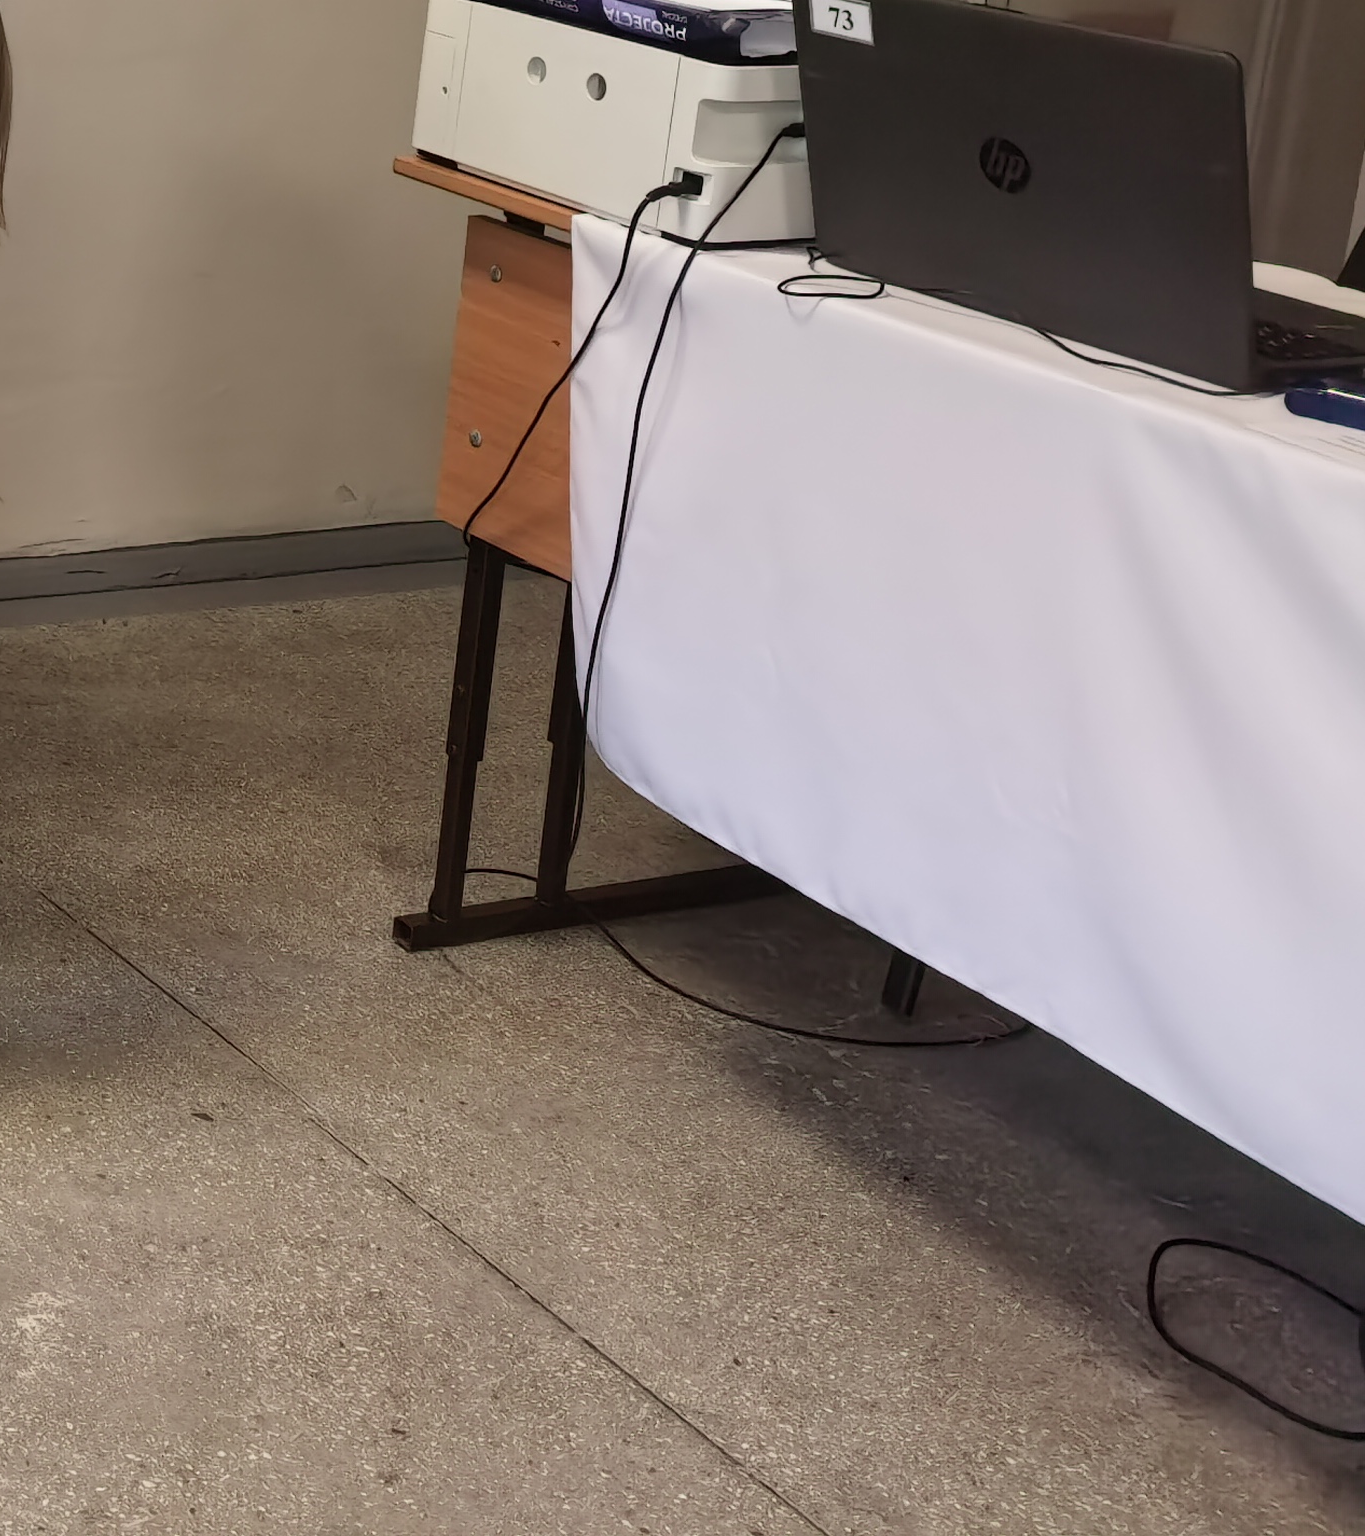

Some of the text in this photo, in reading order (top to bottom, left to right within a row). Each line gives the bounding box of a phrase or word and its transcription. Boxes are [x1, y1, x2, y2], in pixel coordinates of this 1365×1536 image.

[603, 5, 687, 42] PROJECTA
[828, 7, 854, 31] 73
[985, 137, 1026, 192] hp
